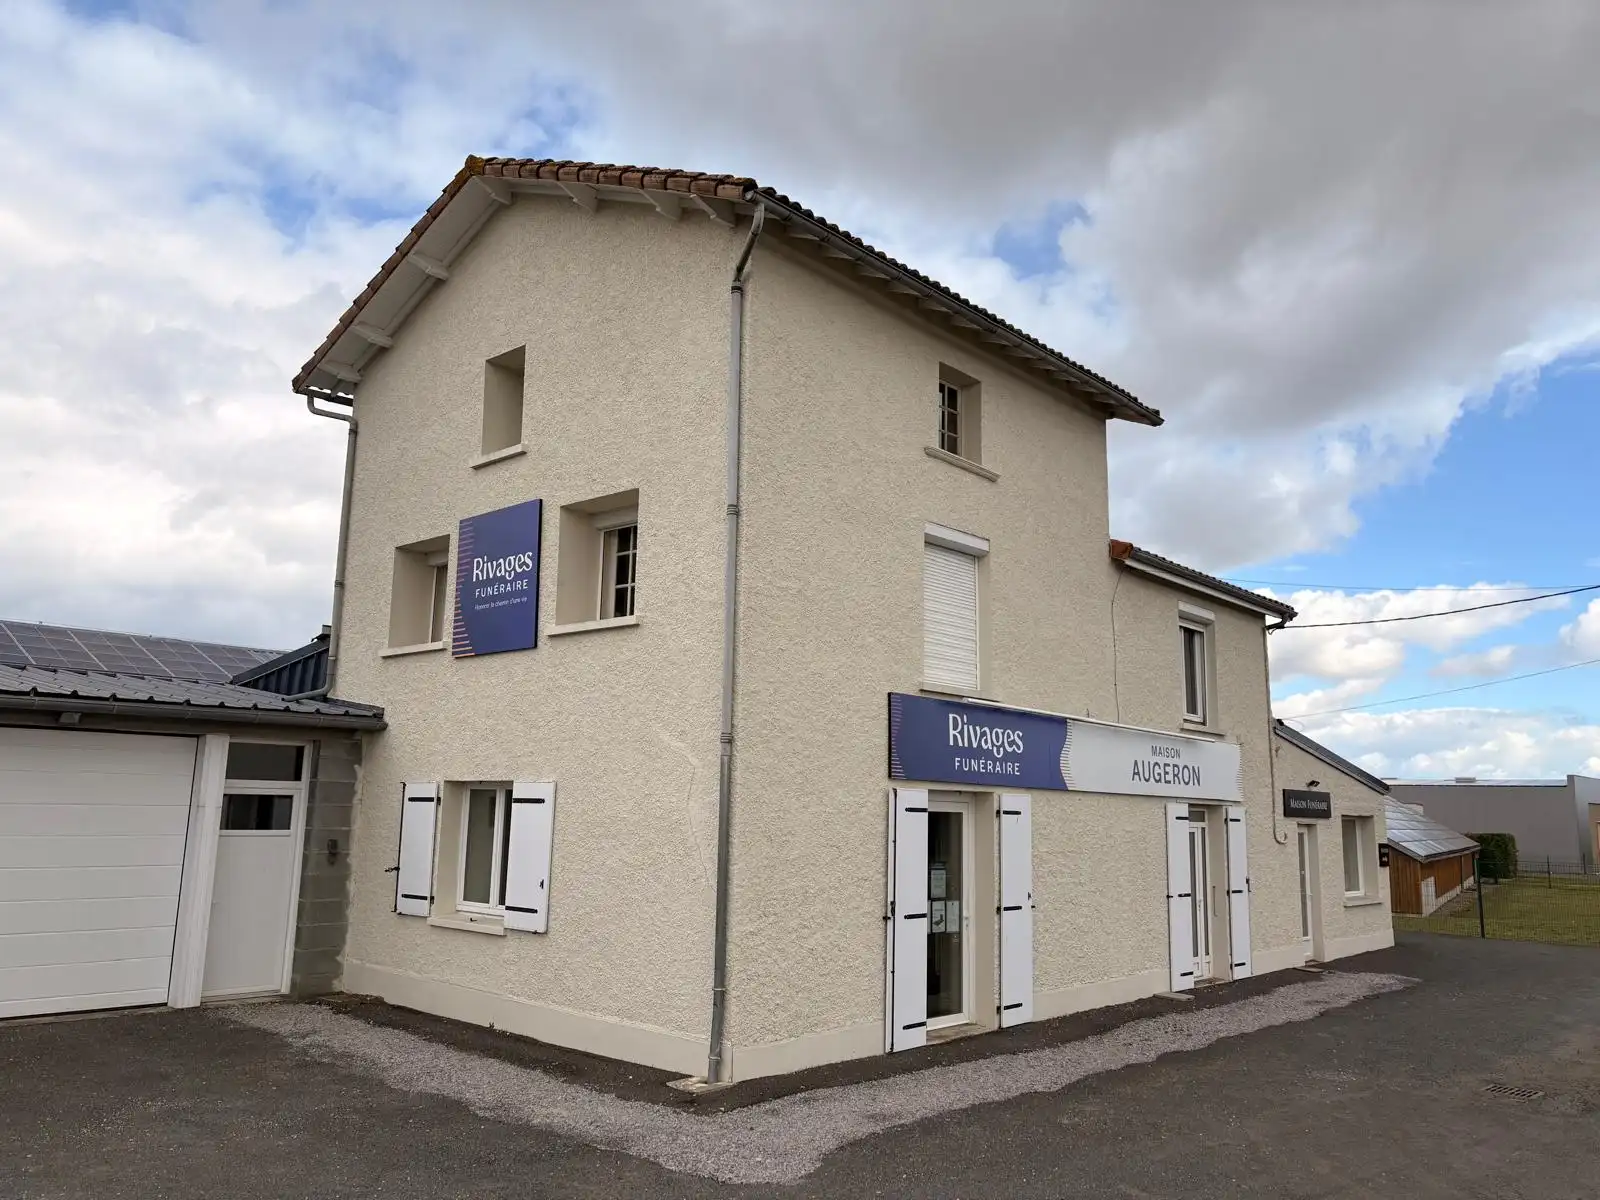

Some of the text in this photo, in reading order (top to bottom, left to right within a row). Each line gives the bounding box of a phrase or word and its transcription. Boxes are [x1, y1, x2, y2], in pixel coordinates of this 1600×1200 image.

[472, 551, 533, 582] Rivages
[475, 579, 529, 598] FUNÉRAIRE
[948, 713, 1024, 758] Rivages
[1151, 745, 1181, 759] MAISON
[955, 756, 1020, 775] FUNÉRAIRE
[1132, 759, 1201, 787] AUGERON
